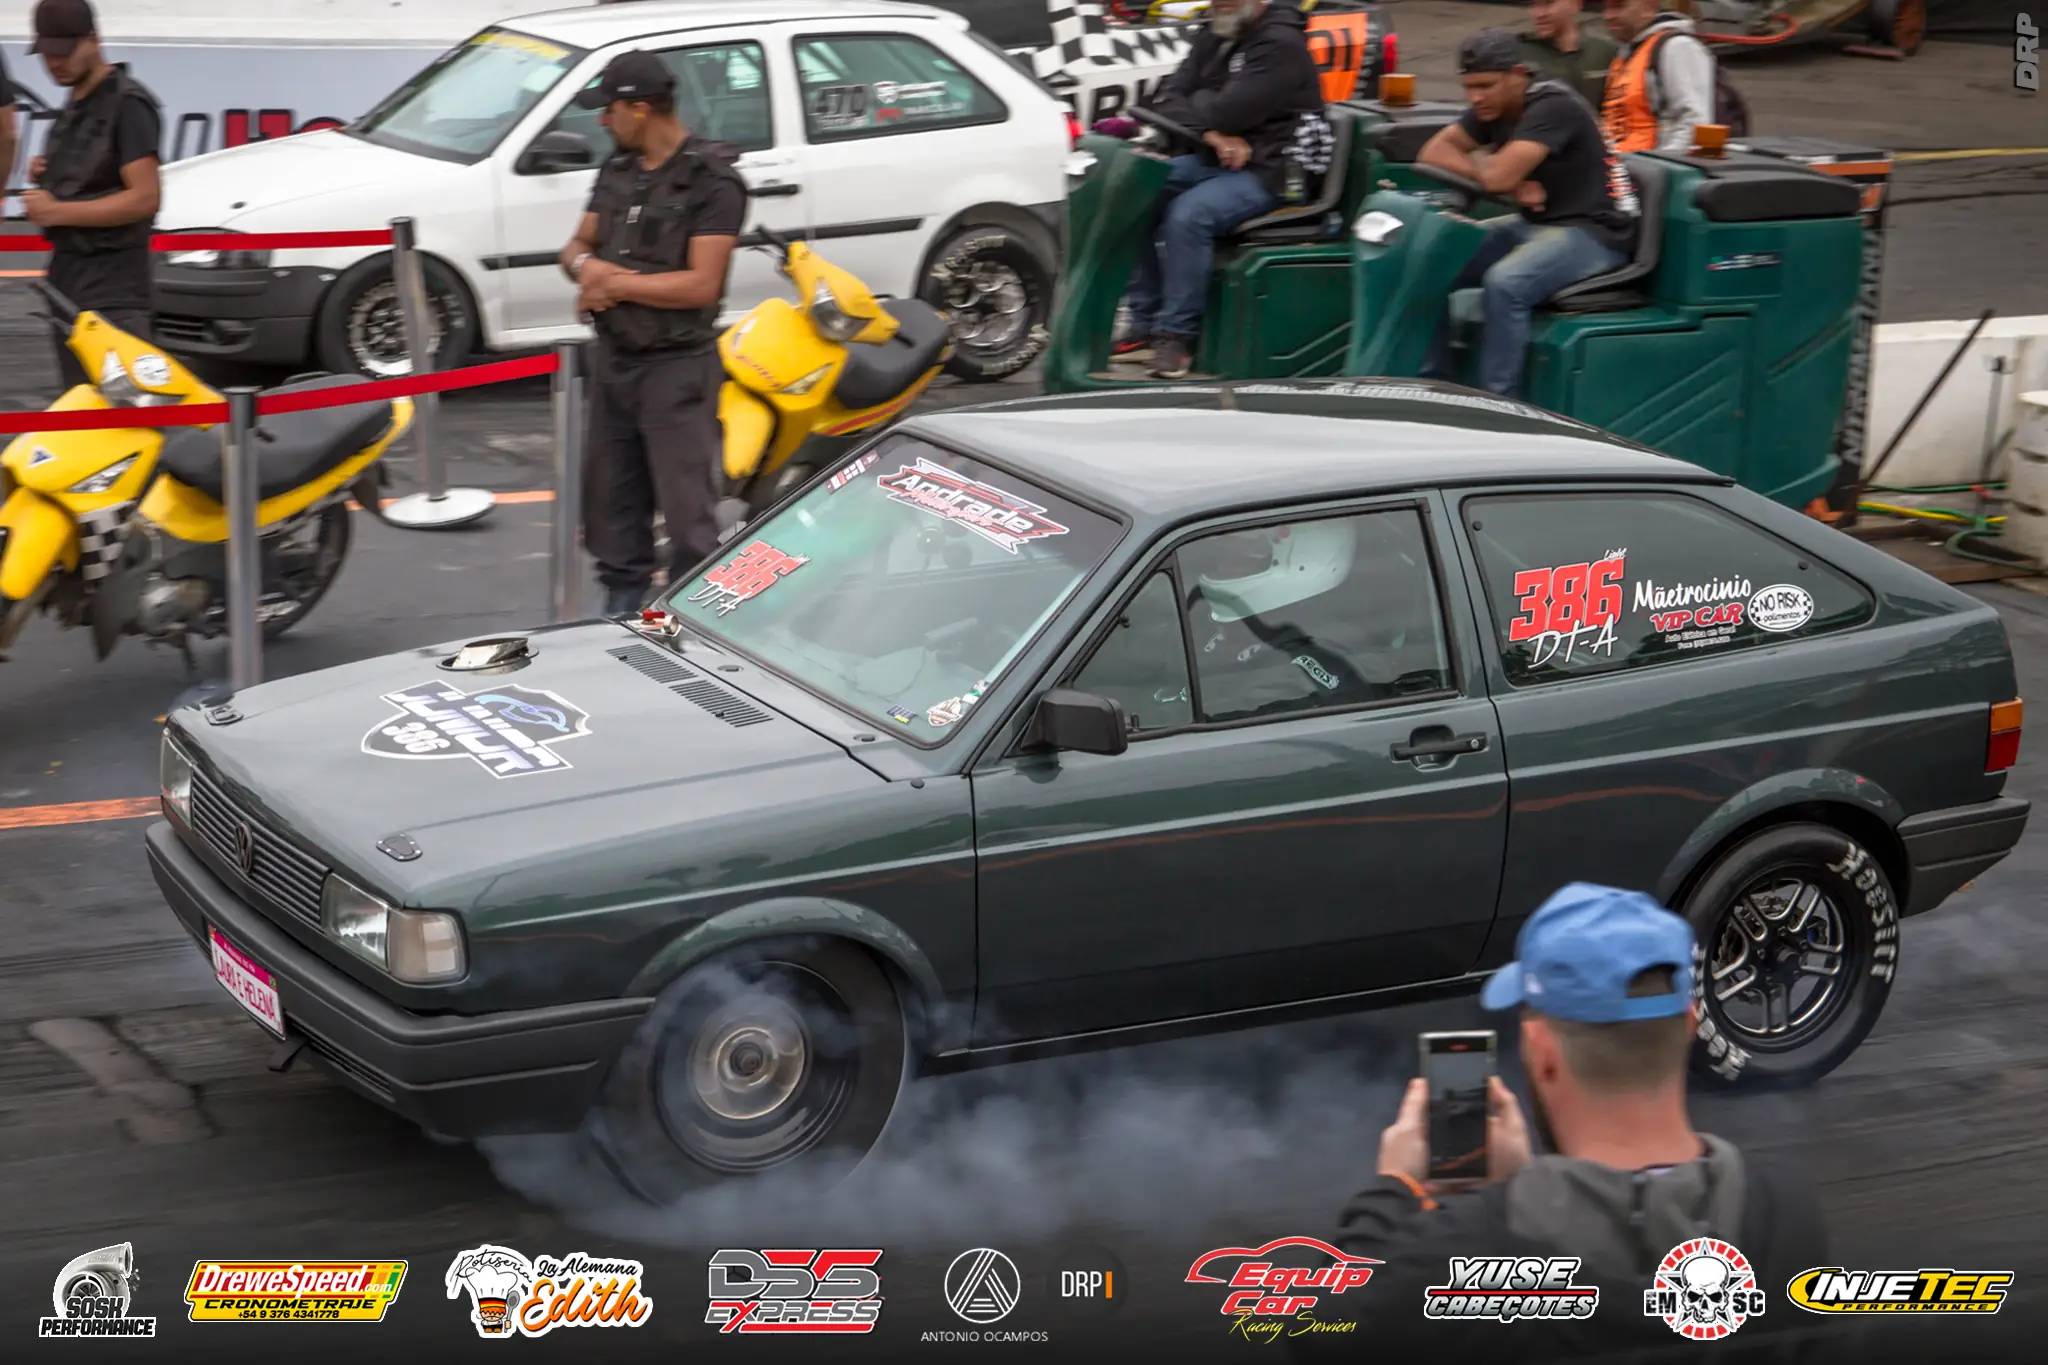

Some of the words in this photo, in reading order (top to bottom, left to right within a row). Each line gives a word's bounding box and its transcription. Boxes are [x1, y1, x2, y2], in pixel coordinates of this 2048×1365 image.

[891, 474, 1033, 533] Andrade
[1509, 558, 1624, 641] 386
[1632, 575, 1751, 612] Mãetrocinio
[1759, 594, 1776, 612] NO
[1777, 592, 1802, 609] RISK
[1527, 613, 1618, 668] DT-A
[1650, 609, 1692, 633] VIP
[1695, 602, 1744, 627] CAR
